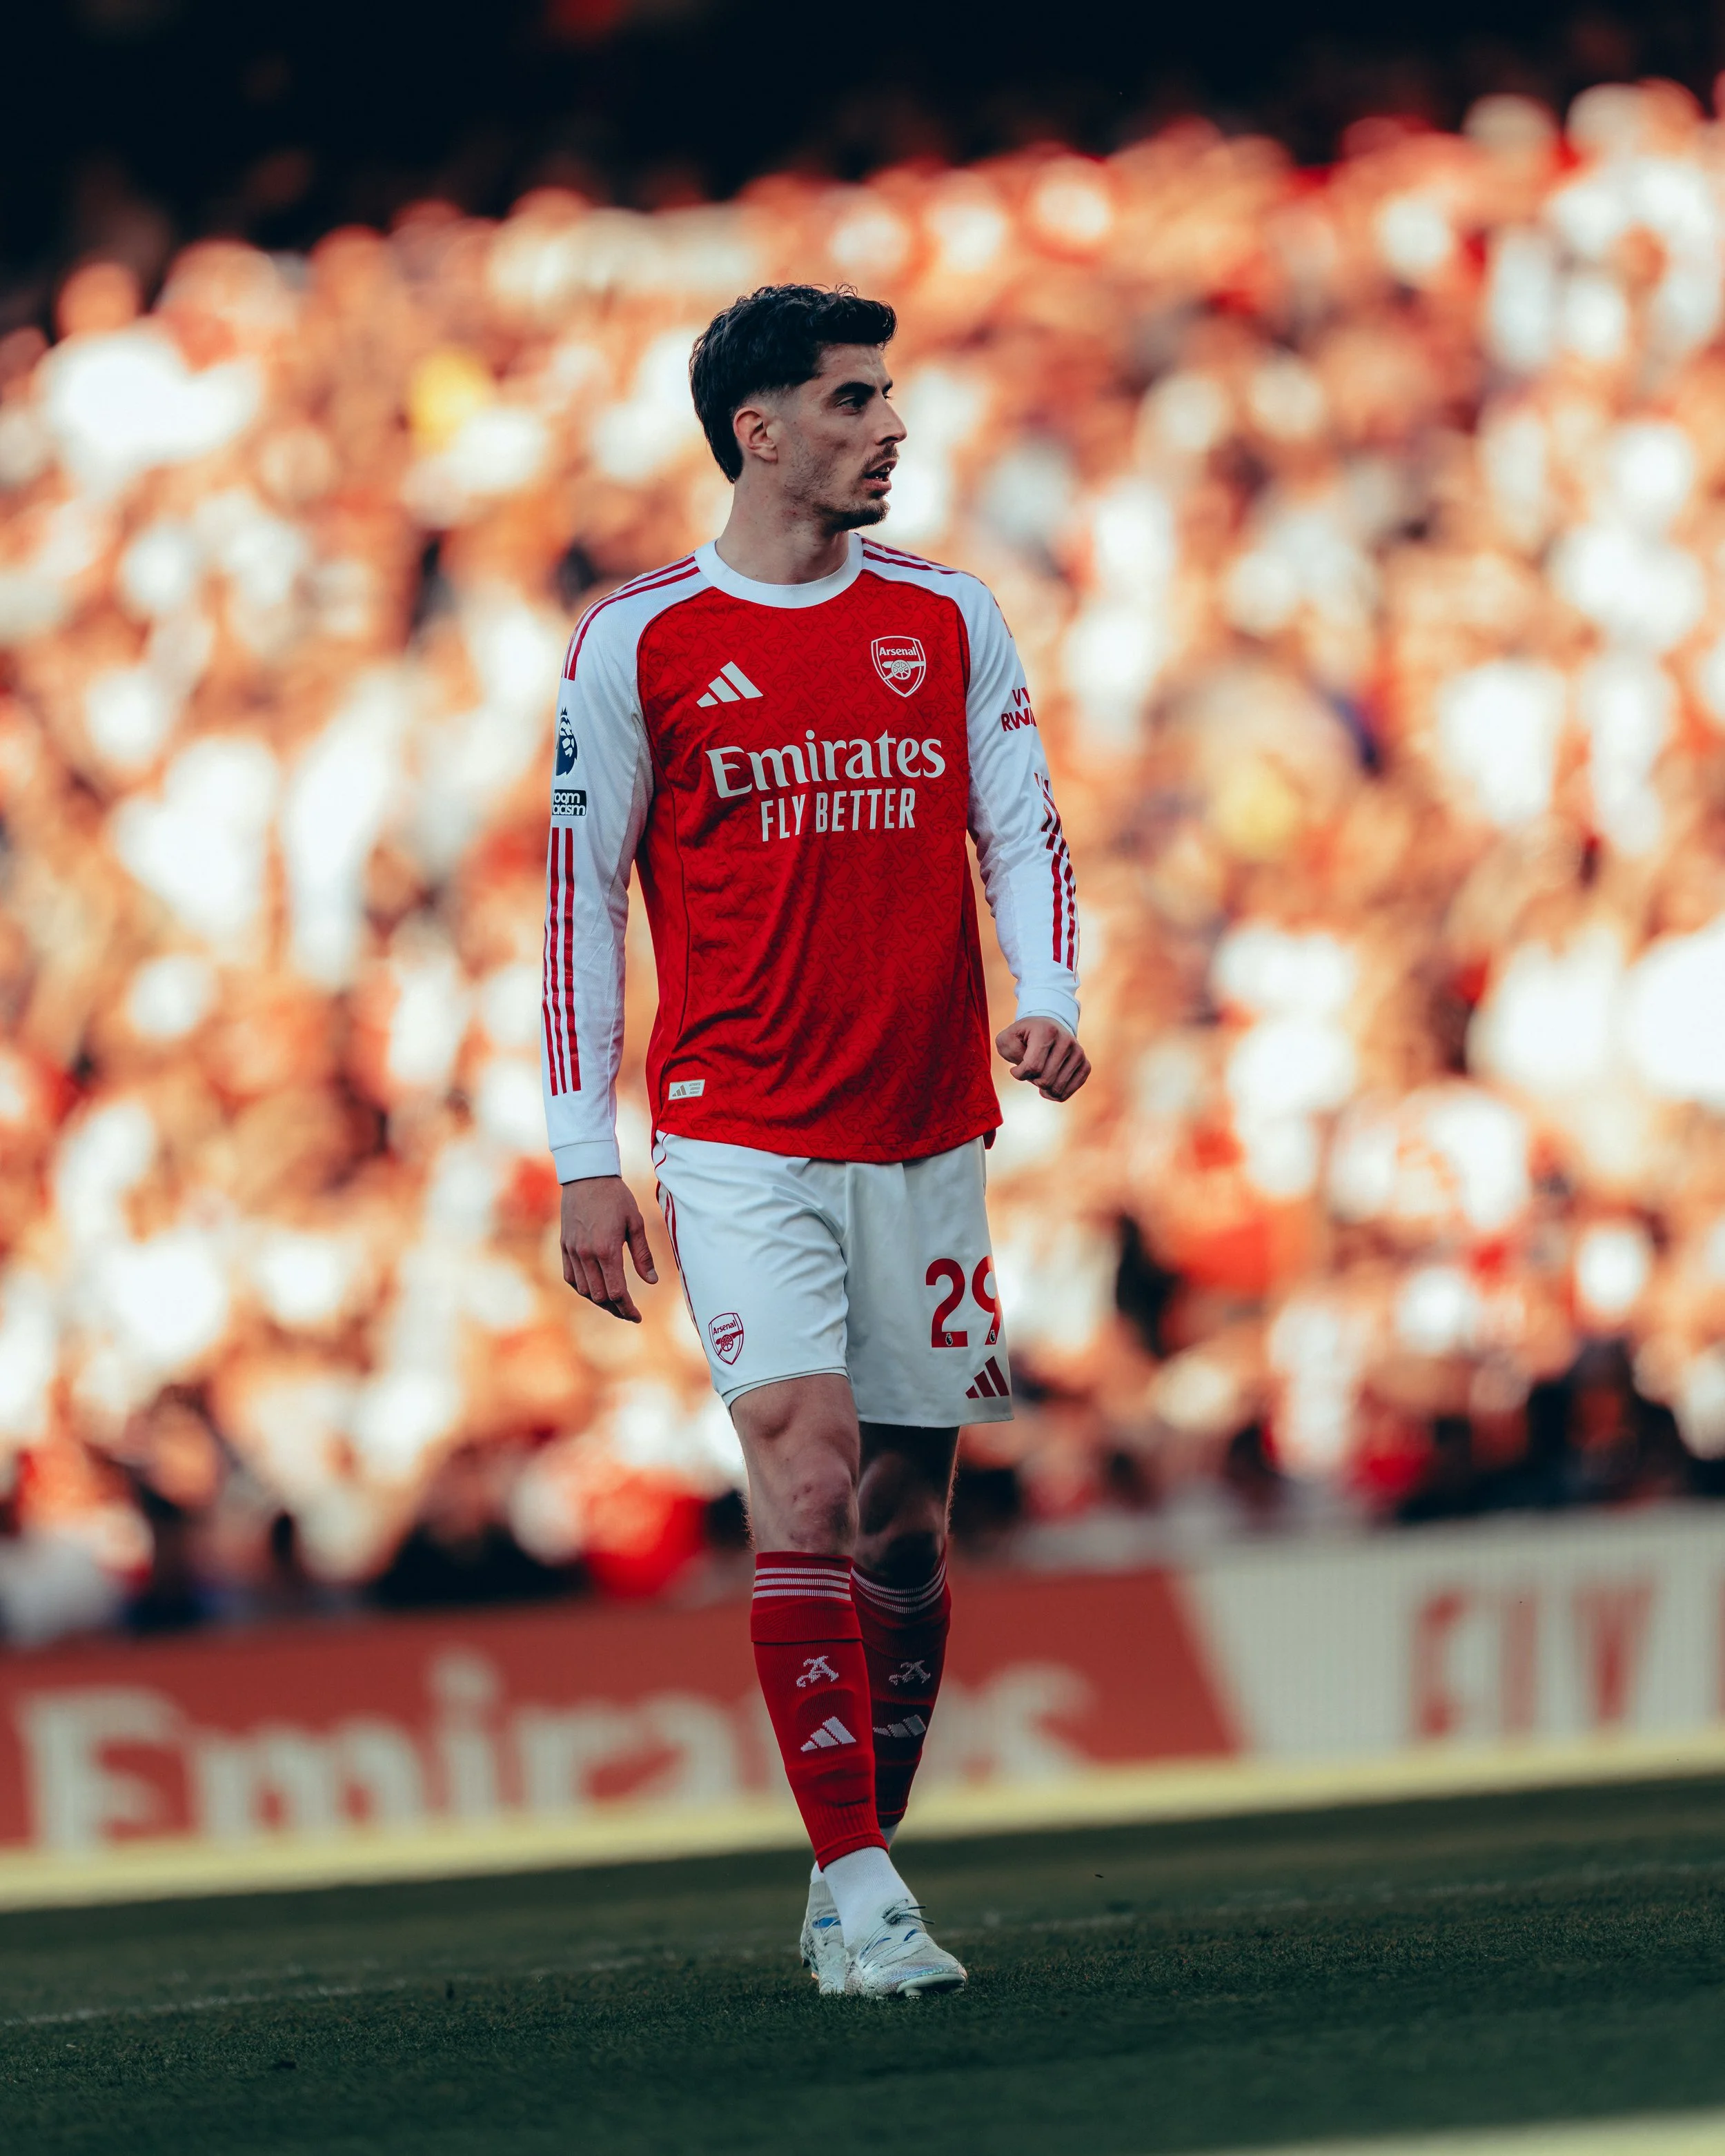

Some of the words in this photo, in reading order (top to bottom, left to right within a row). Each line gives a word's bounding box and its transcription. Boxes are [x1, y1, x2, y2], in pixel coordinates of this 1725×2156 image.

[879, 646, 917, 656] Arsenal
[704, 729, 946, 799] Emirates
[552, 802, 586, 815] acism
[760, 793, 806, 842] FLY
[816, 788, 916, 833] BETTER
[713, 1319, 737, 1336] Arsenal
[925, 1254, 1002, 1348] 29
[17, 1645, 1098, 1859] Emiras
